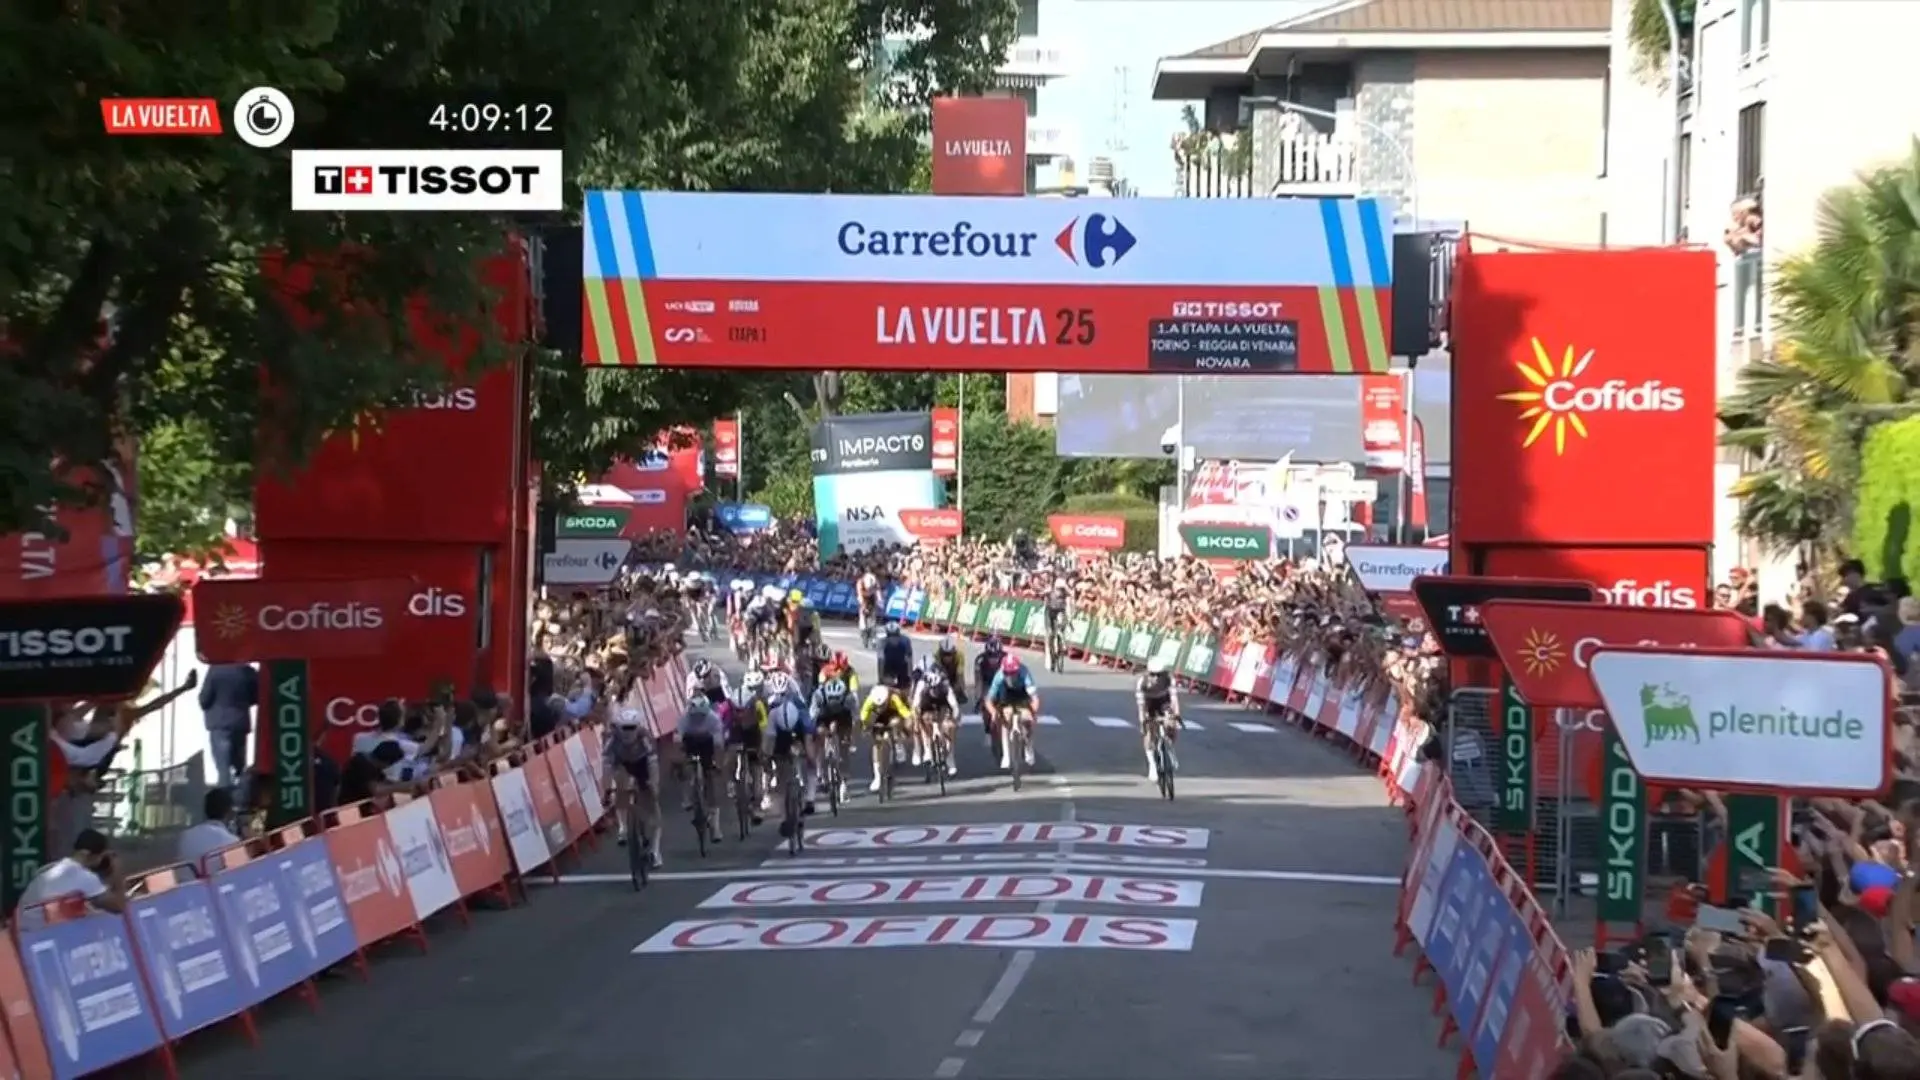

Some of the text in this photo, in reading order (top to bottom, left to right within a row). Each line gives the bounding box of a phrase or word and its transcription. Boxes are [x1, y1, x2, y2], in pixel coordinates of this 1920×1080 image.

[945, 140, 1011, 156] LA VUELTA
[838, 221, 1037, 257] Carrefour
[1204, 302, 1283, 317] TISSOT
[876, 306, 1095, 345] LA VUELTA 25
[1181, 323, 1221, 335] ETAPA
[1223, 323, 1241, 335] LA
[1242, 323, 1290, 335] VUELTA
[1151, 340, 1190, 352] TORINO
[1196, 357, 1251, 369] NOVARA
[1543, 379, 1685, 412] Cofidis
[846, 505, 885, 521] NSA
[1359, 561, 1427, 577] Carrefour
[258, 602, 383, 631] Cofidis
[0, 626, 132, 658] ISSOT
[1709, 705, 1864, 740] plenitude
[804, 824, 1189, 848] COFIDIS
[731, 876, 1181, 905] COFIDIS
[671, 916, 1169, 950] COFIDIS
